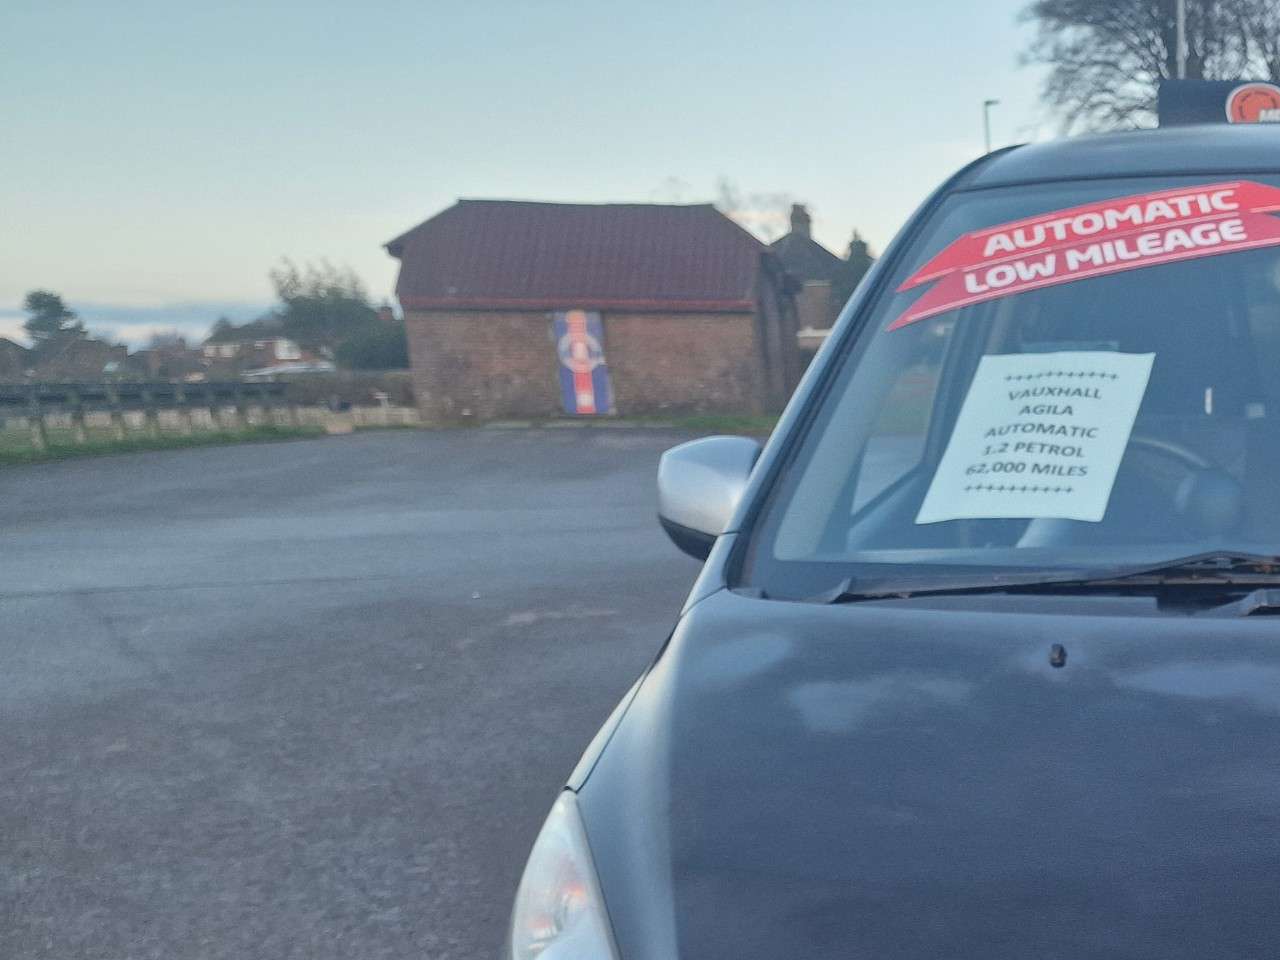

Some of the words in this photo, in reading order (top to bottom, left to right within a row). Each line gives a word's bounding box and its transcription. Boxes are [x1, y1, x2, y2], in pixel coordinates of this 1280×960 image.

[982, 189, 1239, 257] AUTOMATIC
[965, 255, 1056, 294] LOW
[1066, 219, 1247, 272] MILEAGE
[1008, 386, 1102, 401] VAUXHALL
[1019, 404, 1074, 416] AGILA
[984, 422, 1099, 439] AUTOMATIC
[983, 443, 1009, 457] 1.2
[1013, 442, 1086, 458] PETROL
[1031, 463, 1089, 477] MILES
